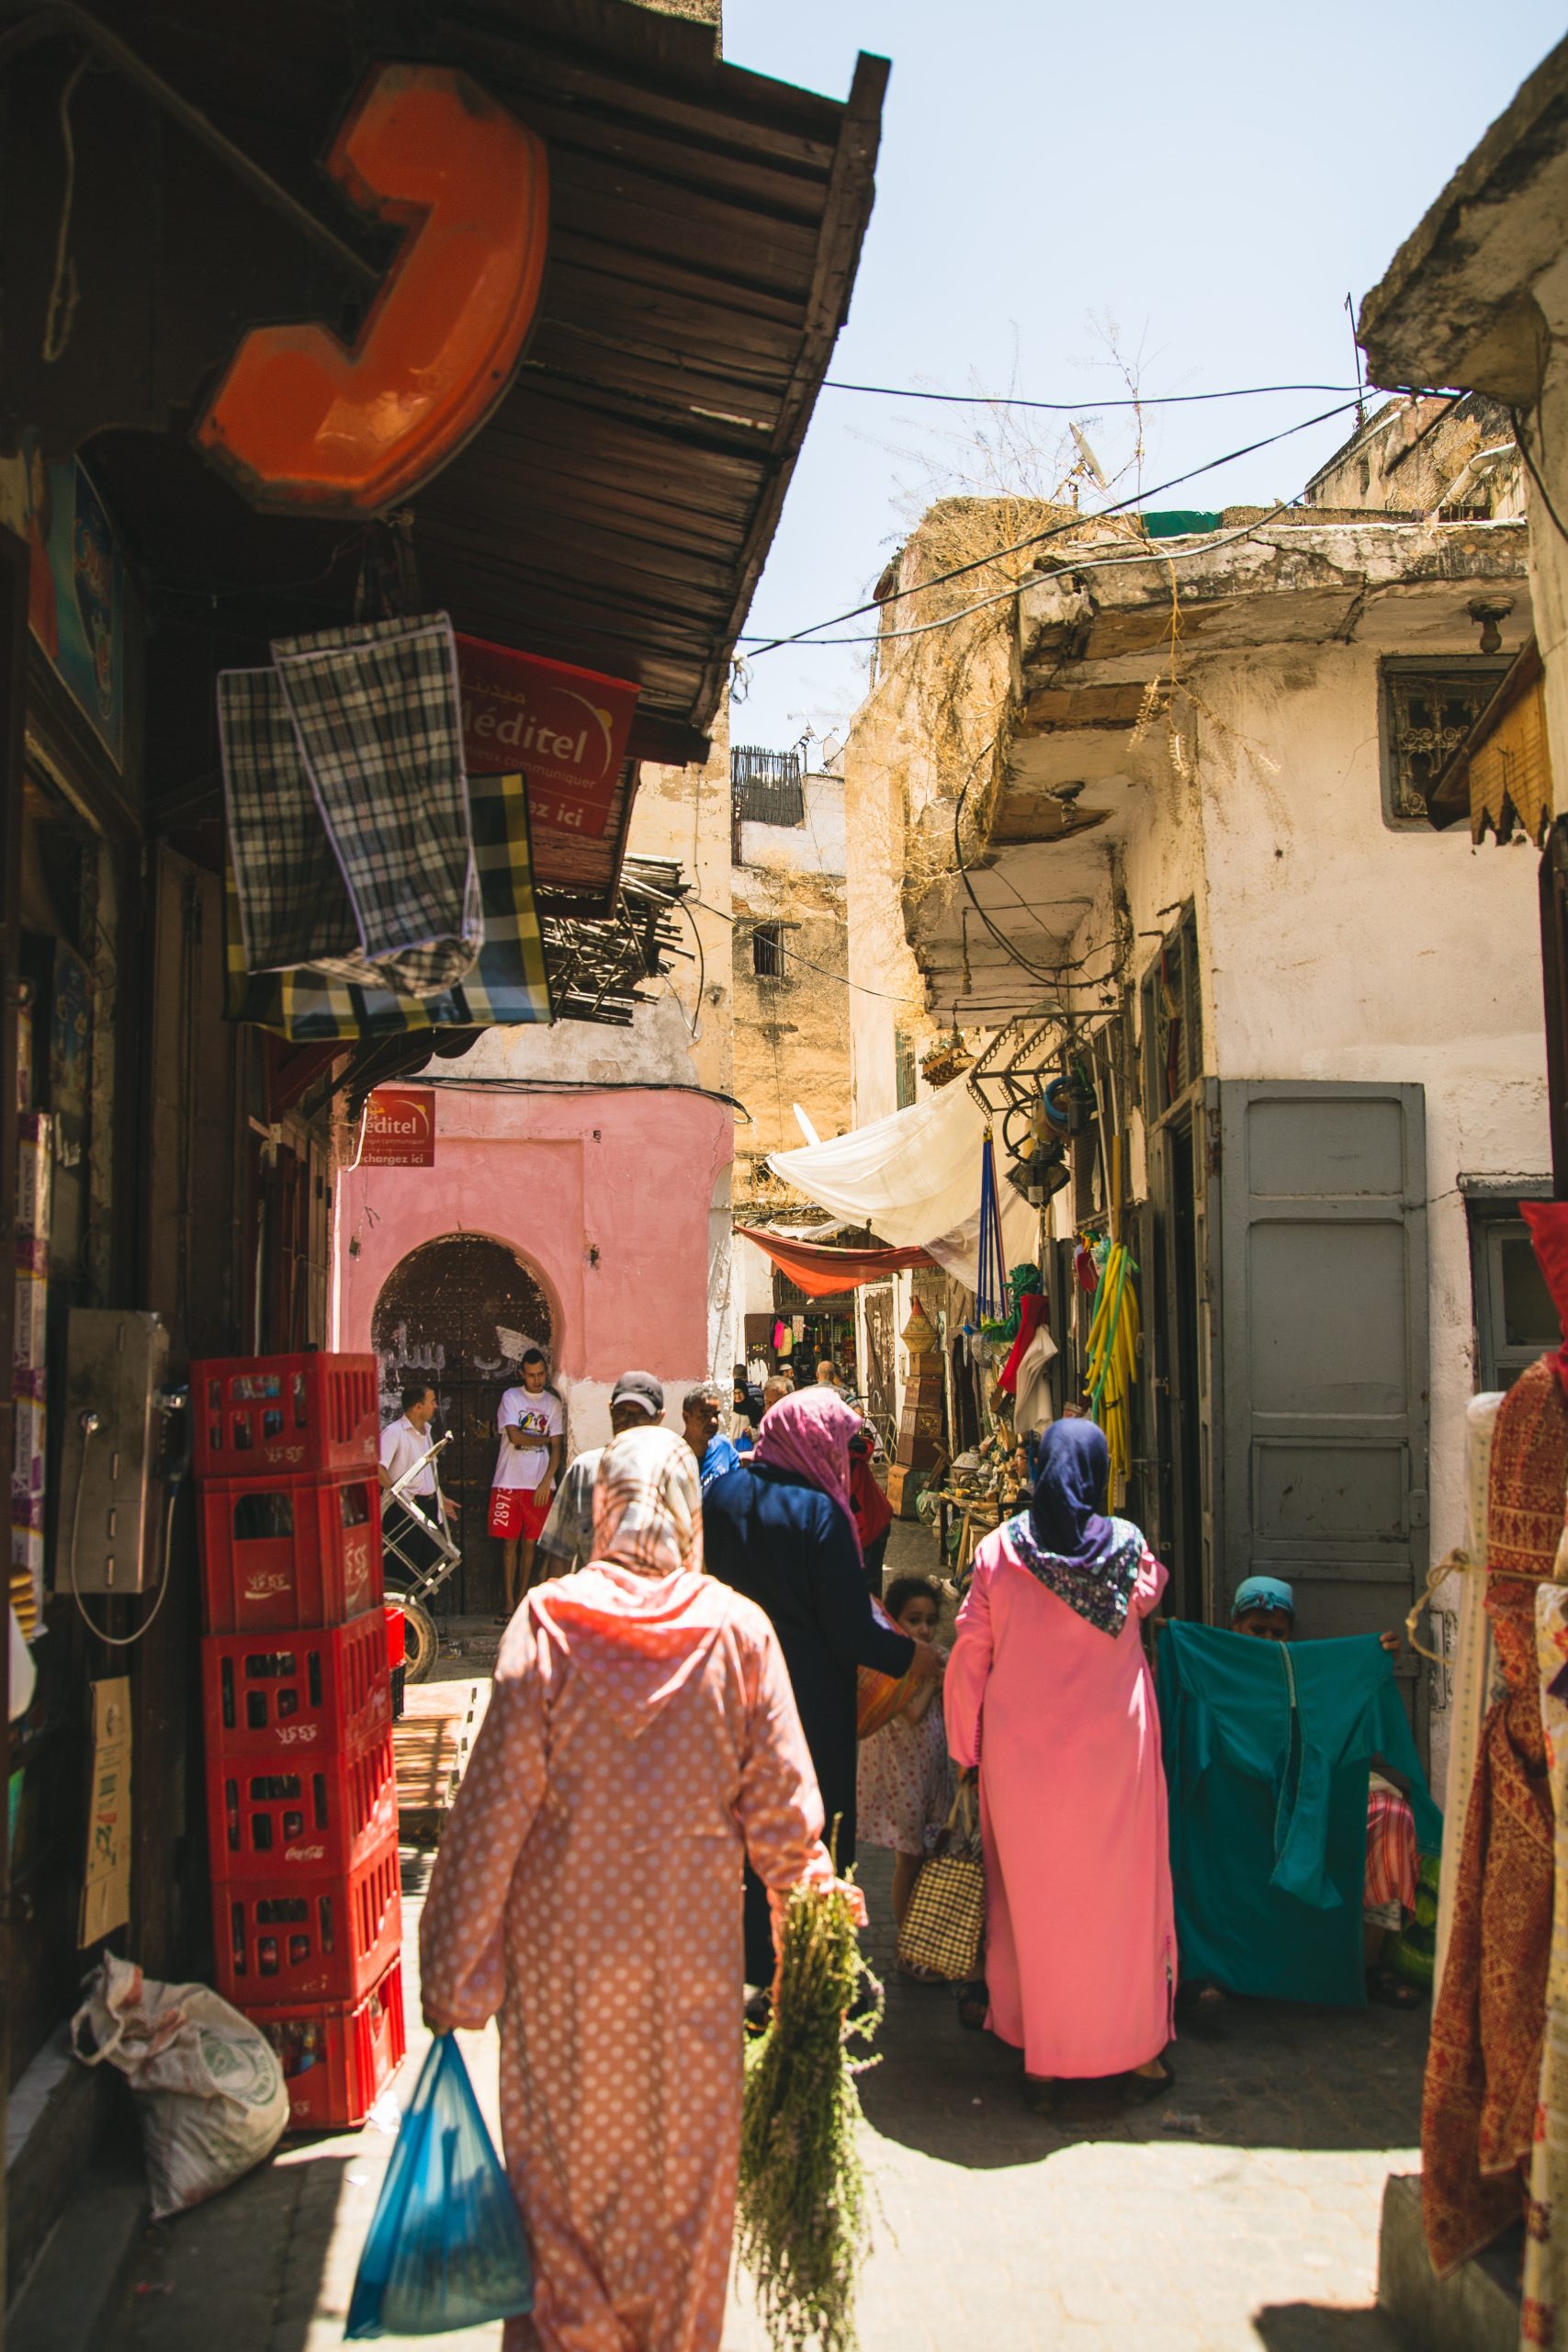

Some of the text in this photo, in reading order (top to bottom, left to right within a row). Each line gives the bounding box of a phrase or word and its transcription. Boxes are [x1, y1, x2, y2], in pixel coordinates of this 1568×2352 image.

[505, 754, 596, 790] communiquer
[557, 803, 584, 827] ici
[366, 1116, 416, 1134] éditel
[364, 1153, 423, 1166] chargez ici
